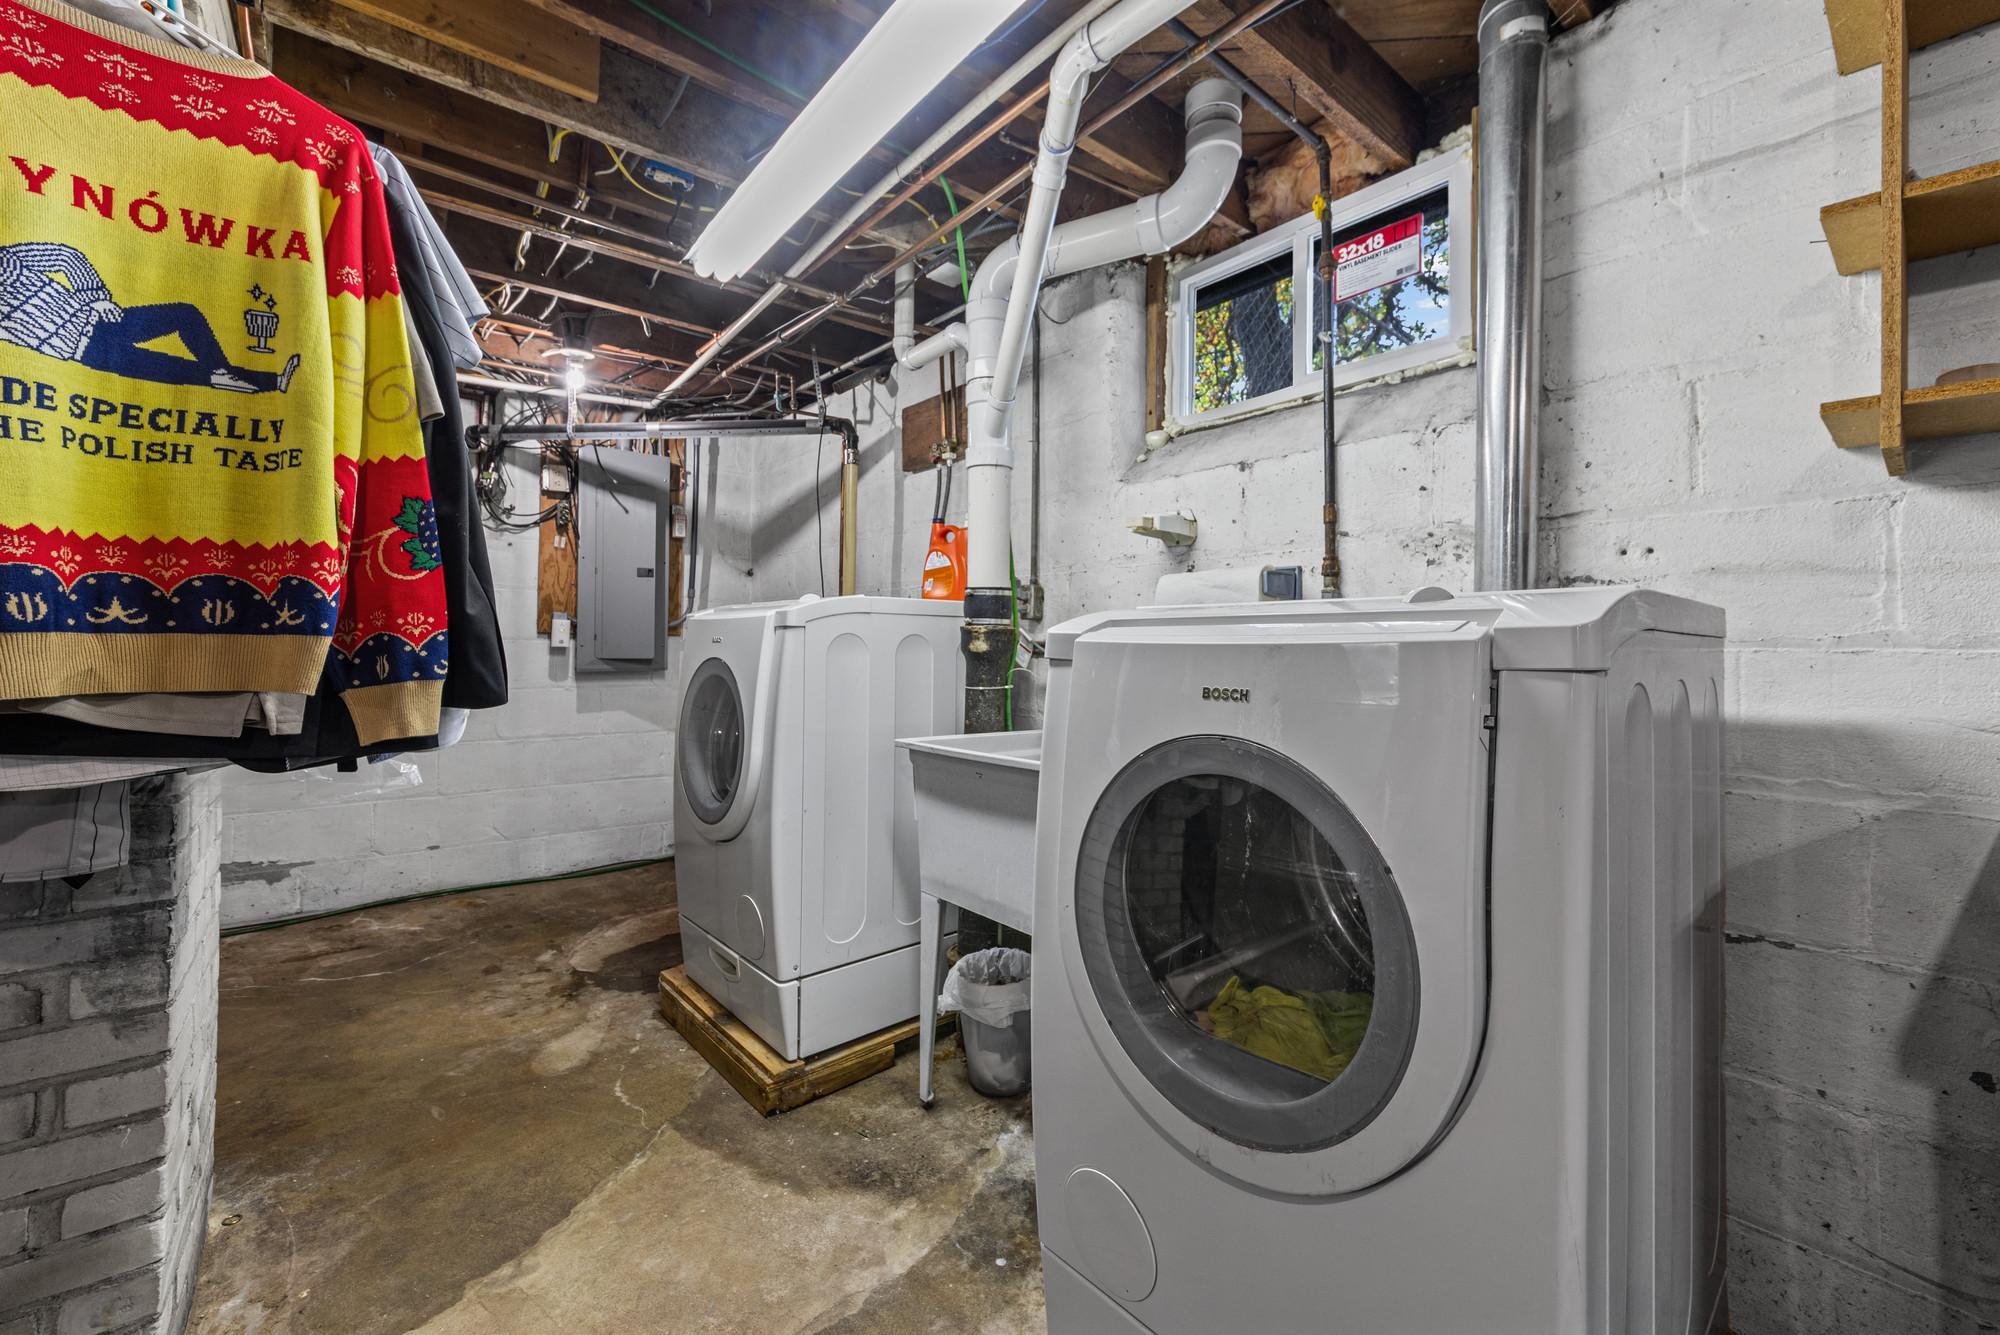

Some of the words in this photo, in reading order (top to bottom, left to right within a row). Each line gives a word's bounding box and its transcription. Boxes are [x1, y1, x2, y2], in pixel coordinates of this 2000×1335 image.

[8, 155, 313, 263] YNÓWKA
[1338, 233, 1384, 263] 32x18
[1353, 250, 1383, 267] BASEMENT
[0, 376, 58, 411] DE
[69, 393, 284, 443] SPECIALLY
[60, 425, 194, 464] POLISH
[213, 447, 303, 473] TASTE
[1202, 686, 1249, 703] BOSCH
